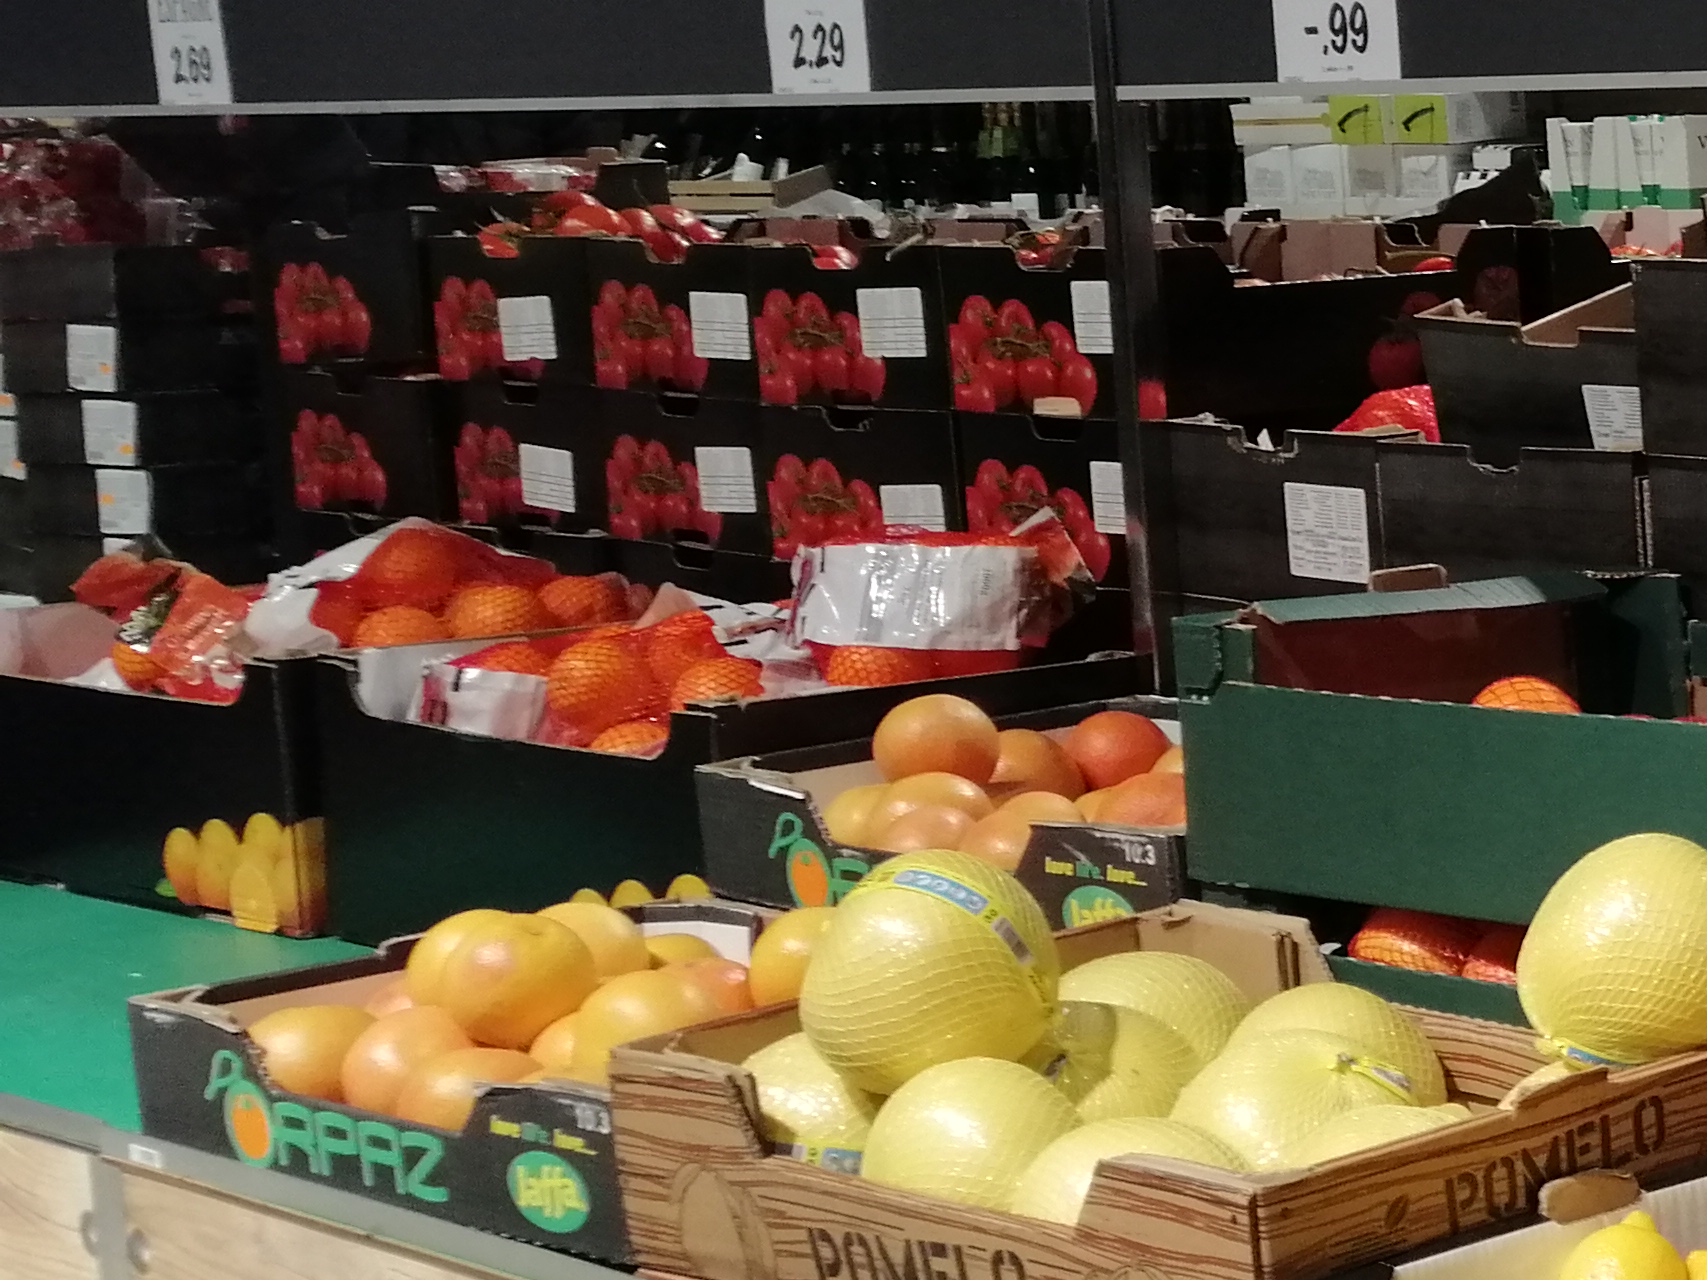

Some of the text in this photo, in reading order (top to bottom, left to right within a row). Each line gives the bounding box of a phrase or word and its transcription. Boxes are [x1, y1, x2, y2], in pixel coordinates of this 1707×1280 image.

[789, 20, 846, 71] 2.29
[1304, 1, 1369, 55] -.99
[171, 45, 213, 85] 2.69
[1445, 1096, 1665, 1235] POMELO
